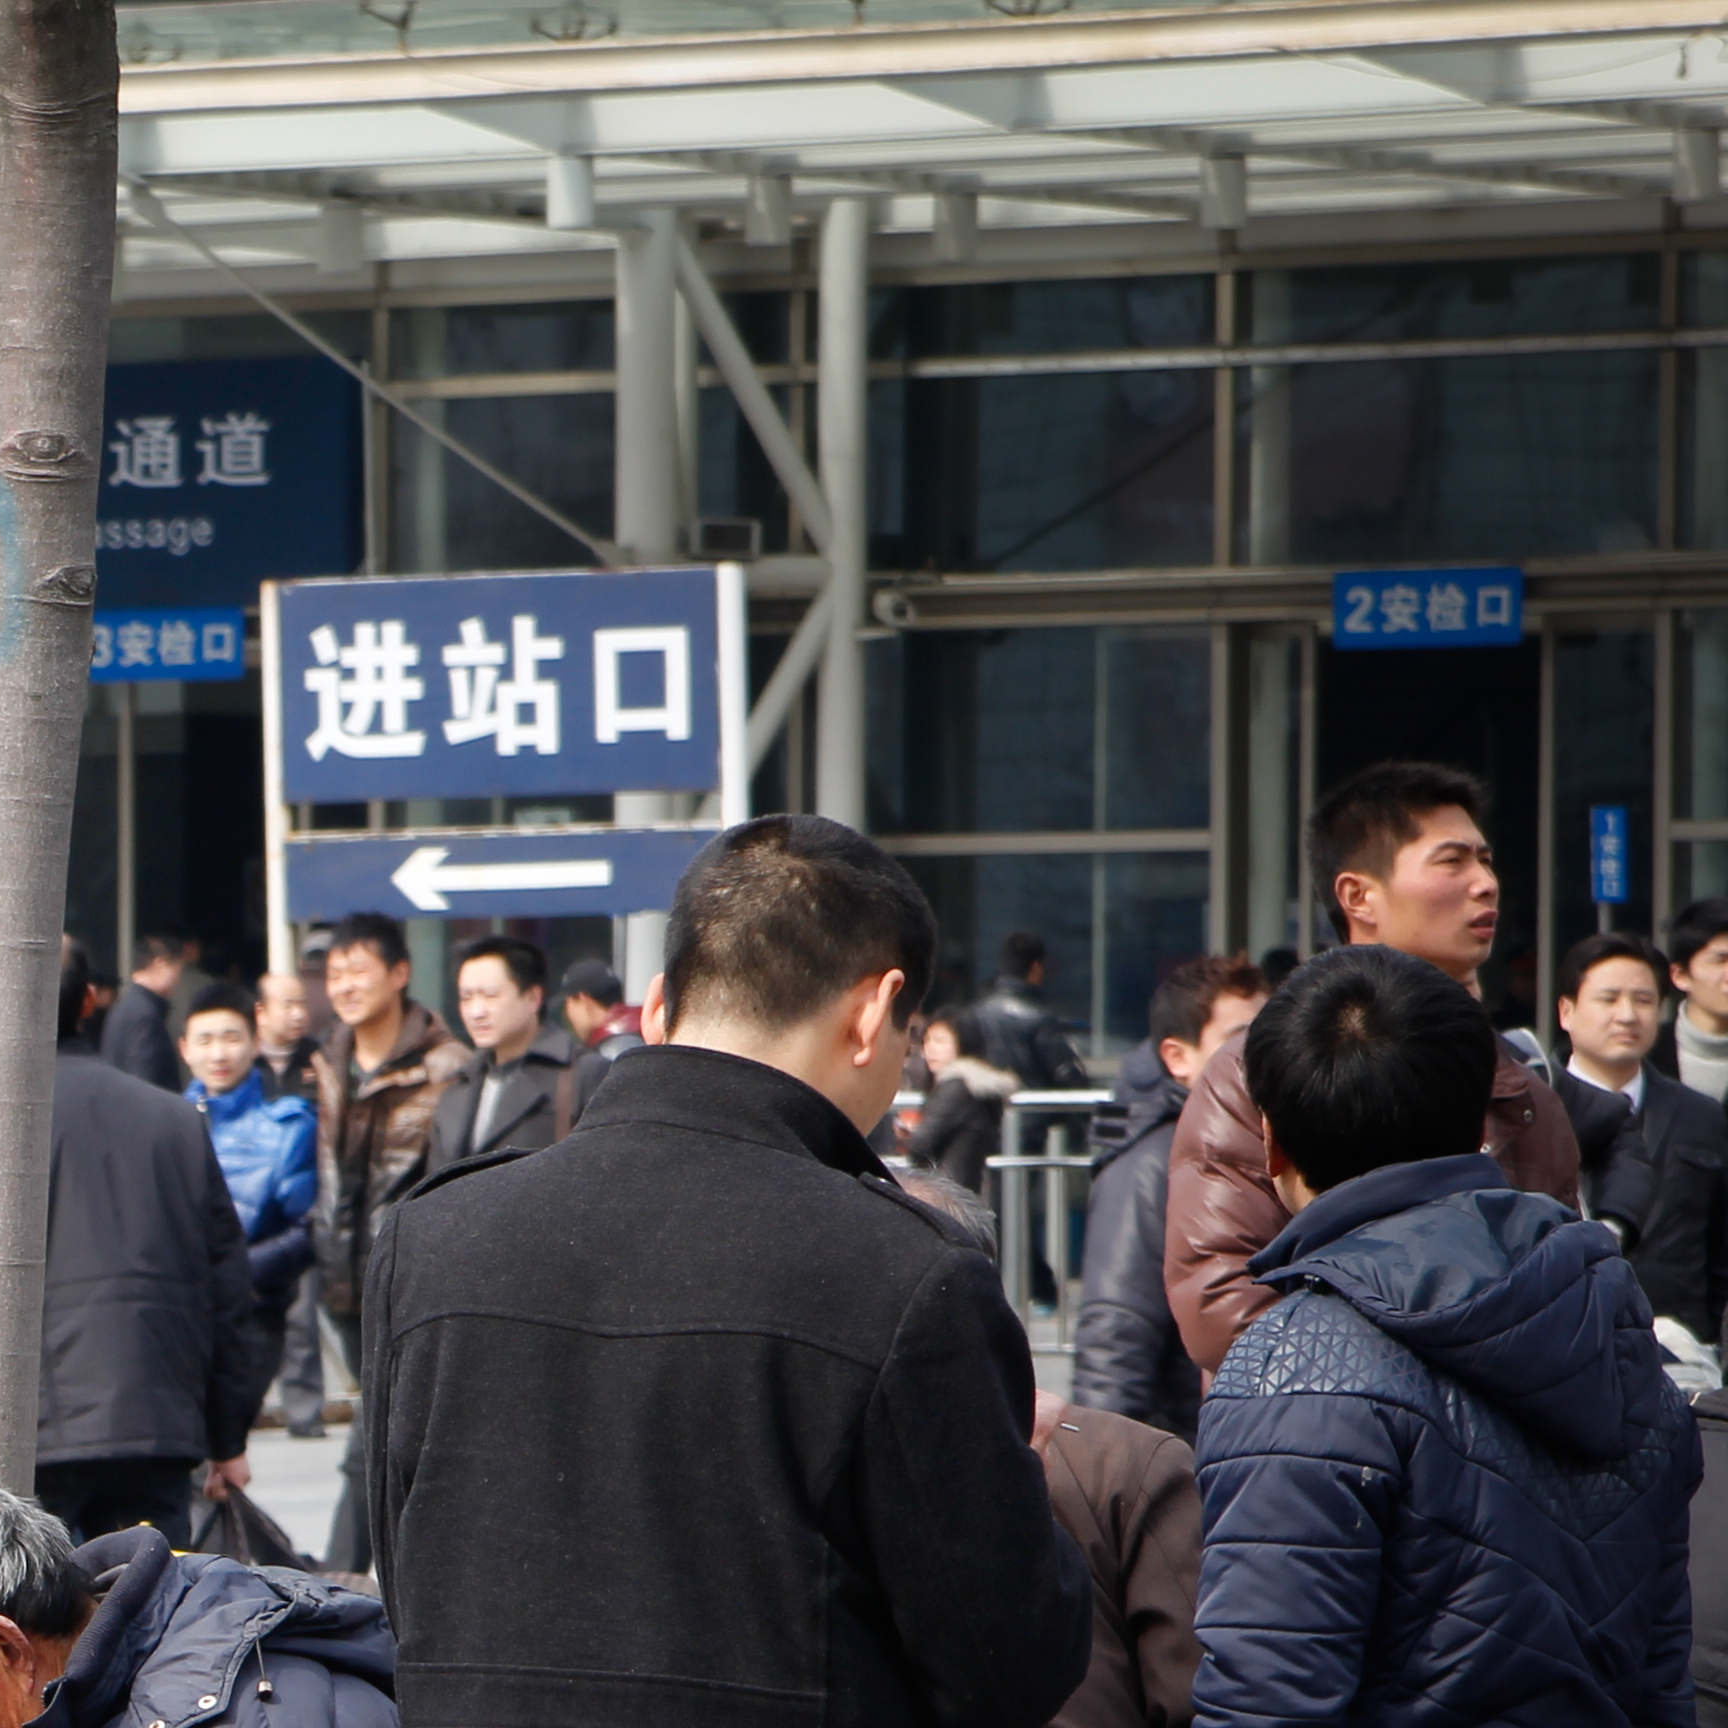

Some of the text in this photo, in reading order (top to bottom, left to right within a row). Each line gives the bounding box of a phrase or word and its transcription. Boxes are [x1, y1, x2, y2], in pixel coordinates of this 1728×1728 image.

[95, 513, 215, 556] assage
[1345, 584, 1513, 635] 2安检口
[91, 620, 236, 667] 3安检口
[304, 614, 693, 763] 进站口
